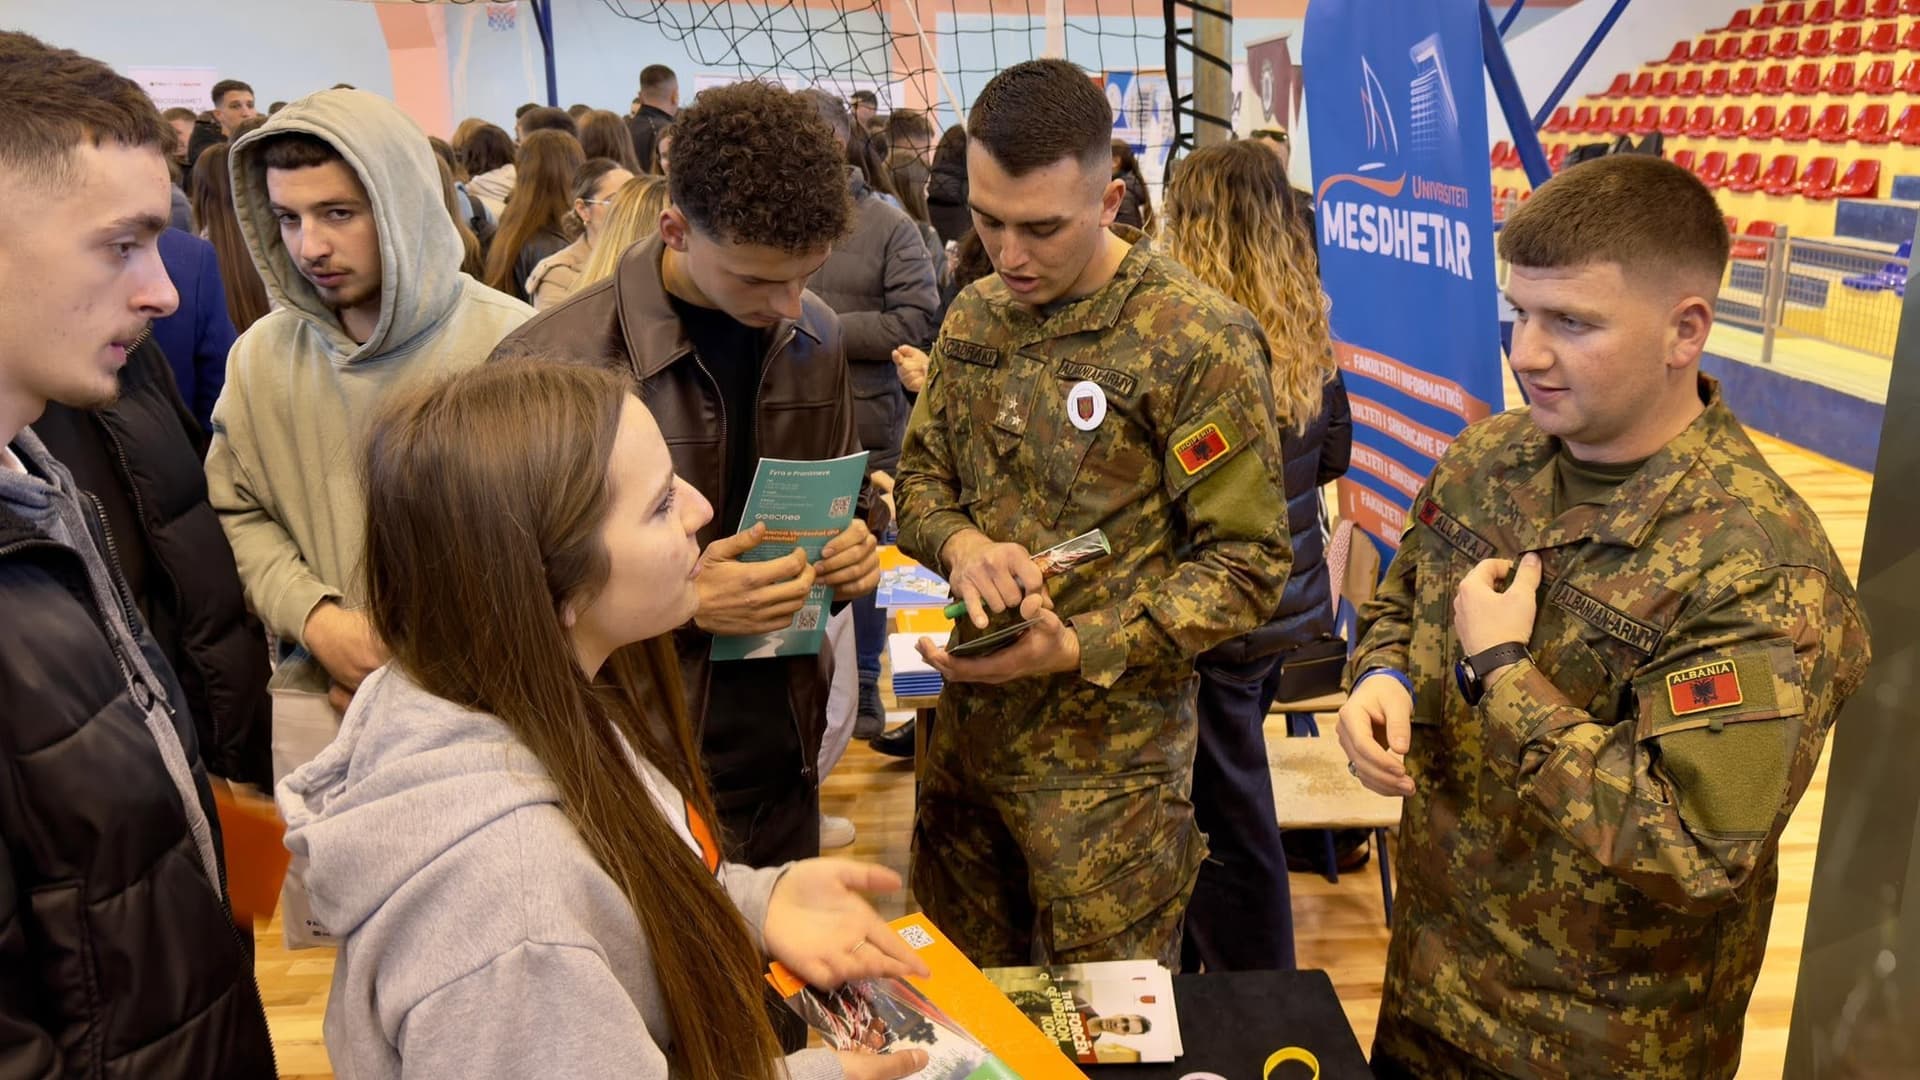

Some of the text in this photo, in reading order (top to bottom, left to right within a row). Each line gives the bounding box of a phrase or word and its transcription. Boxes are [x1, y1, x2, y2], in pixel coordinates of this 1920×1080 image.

[1322, 200, 1473, 280] MESDHETAR
[1350, 400, 1383, 427] KULTETI
[1557, 586, 1653, 649] ALBANIAN-ARMY
[1673, 663, 1731, 685] ALBANIA
[1050, 998, 1073, 1041] NDERON
